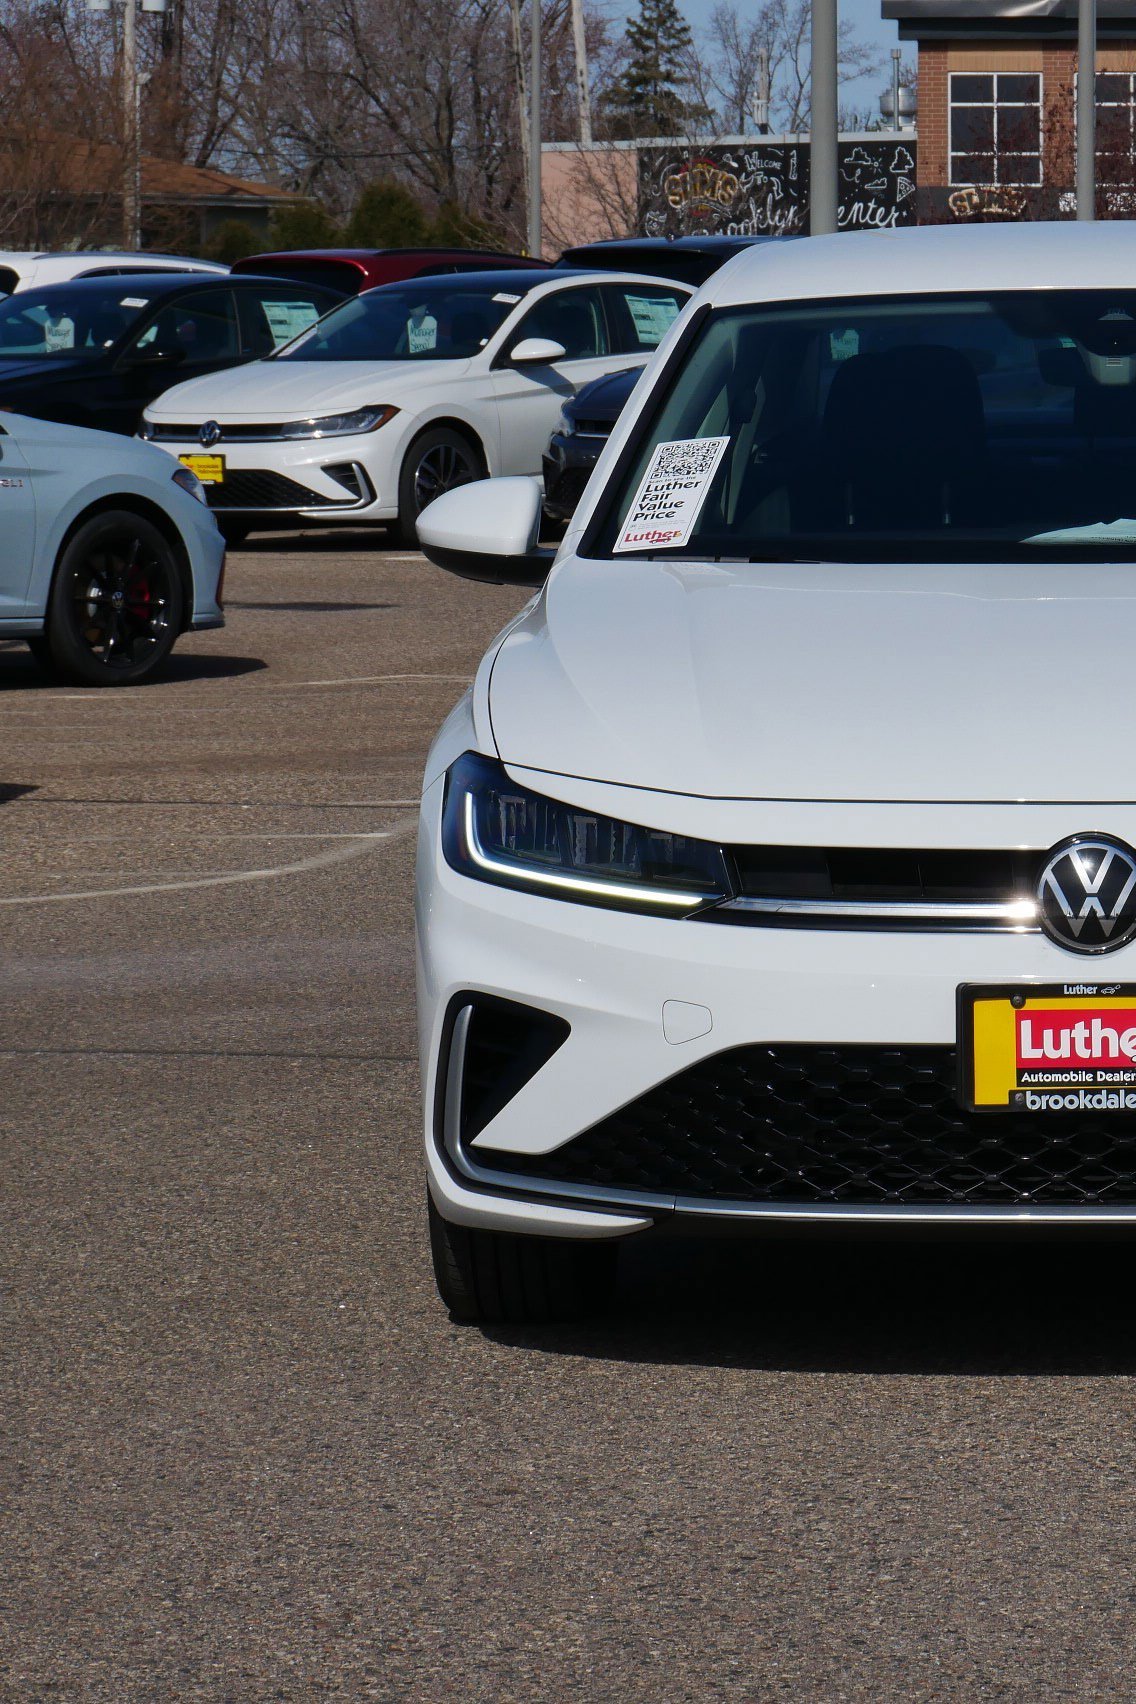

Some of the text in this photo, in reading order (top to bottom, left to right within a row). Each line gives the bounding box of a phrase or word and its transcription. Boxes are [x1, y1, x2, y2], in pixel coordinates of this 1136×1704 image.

[837, 198, 897, 228] enter
[645, 480, 702, 493] Luther
[641, 491, 673, 503] Fair
[638, 500, 685, 511] Value
[633, 510, 677, 522] Price
[624, 530, 682, 542] Luther
[1063, 984, 1098, 995] Luther
[1021, 1071, 1094, 1083] Automobile
